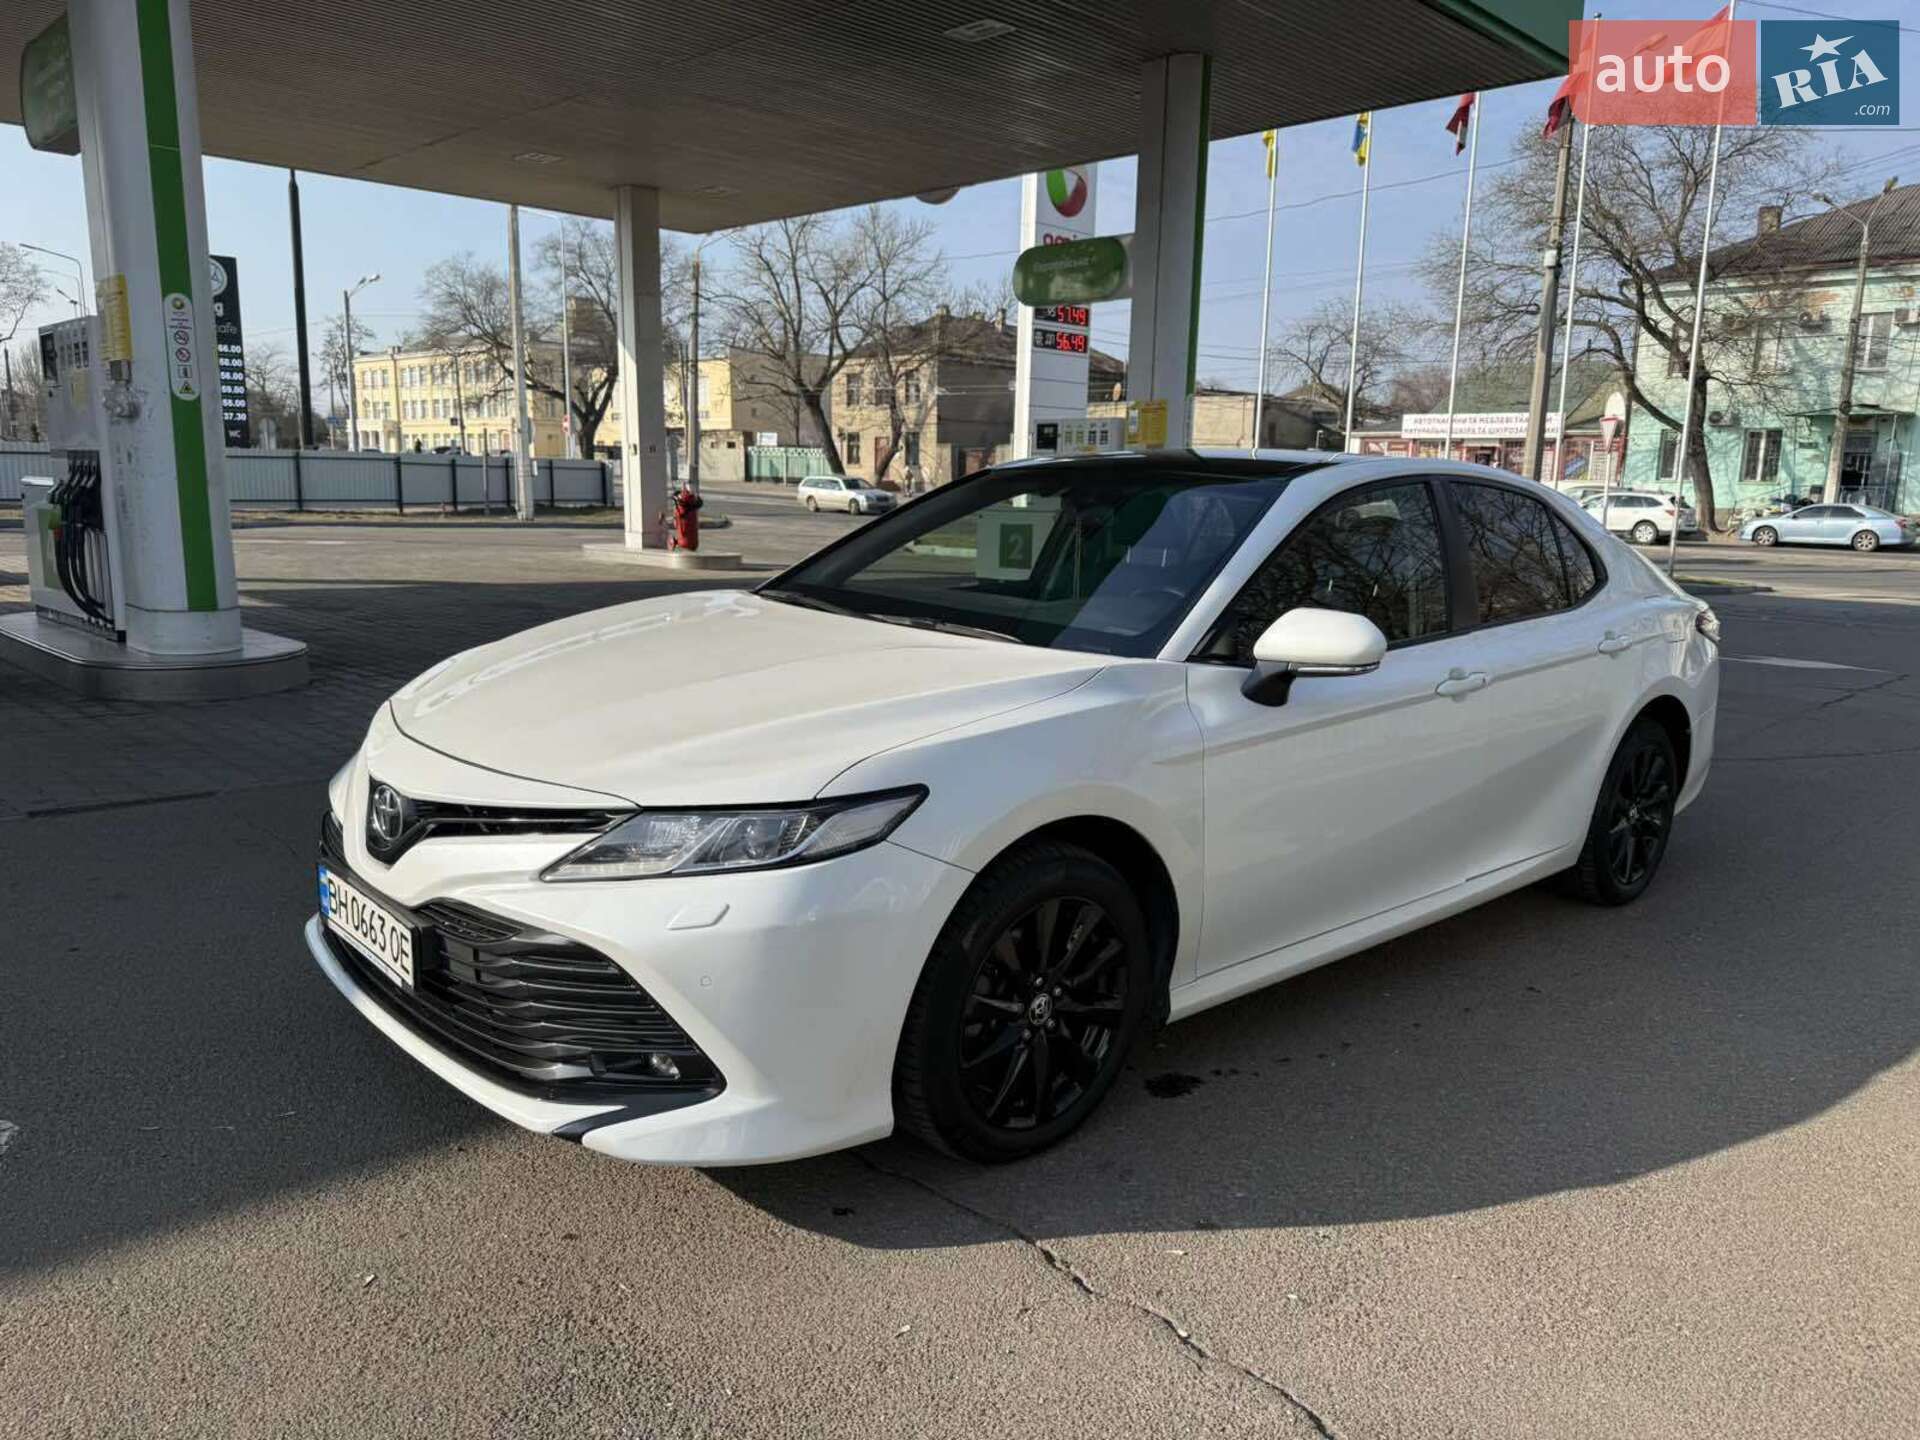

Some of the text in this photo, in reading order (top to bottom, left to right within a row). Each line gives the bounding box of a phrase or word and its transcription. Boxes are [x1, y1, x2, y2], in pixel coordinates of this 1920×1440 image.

[1056, 331, 1085, 353] 56.49
[1008, 533, 1023, 560] 2
[328, 878, 349, 925] BH
[351, 896, 387, 952] 0663
[390, 926, 410, 976] OE
